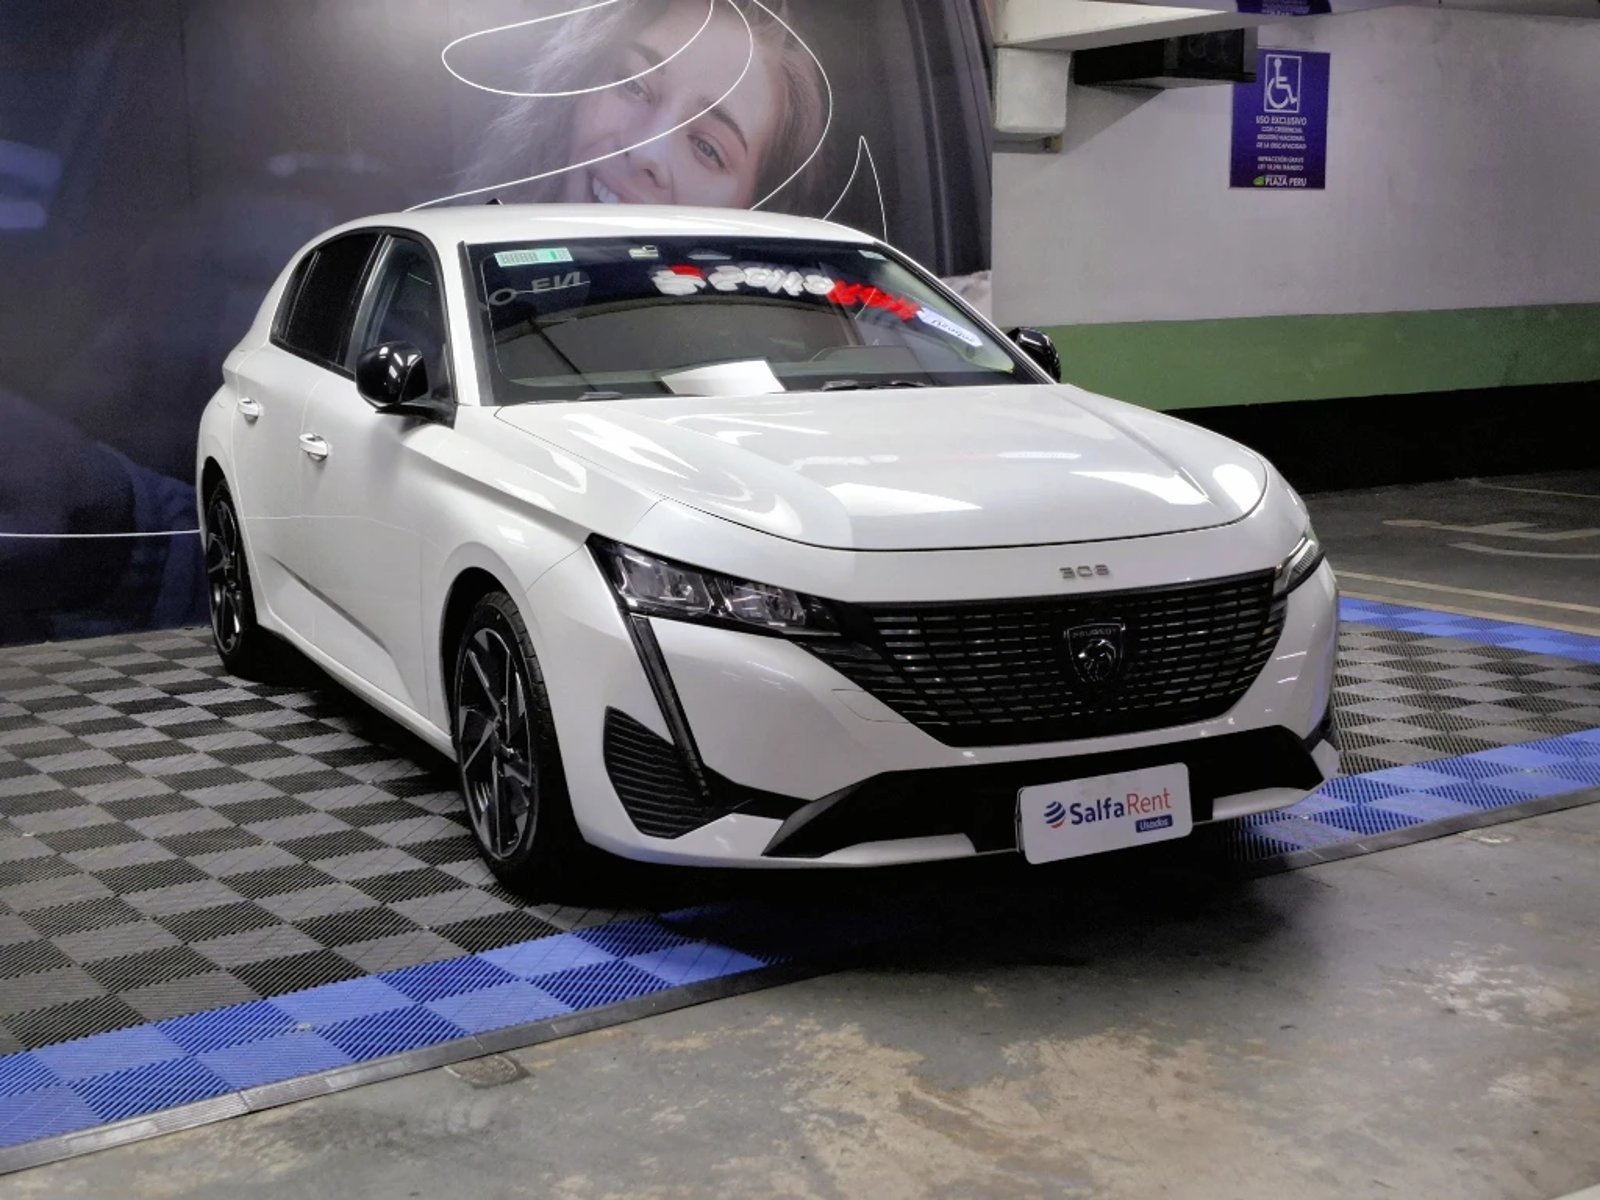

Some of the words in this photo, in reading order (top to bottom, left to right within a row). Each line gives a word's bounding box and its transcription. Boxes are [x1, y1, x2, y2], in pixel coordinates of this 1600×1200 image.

[1256, 115, 1270, 124] USO
[1271, 116, 1307, 126] EXCLUSIVO
[1265, 177, 1288, 187] PLAZA
[1289, 177, 1307, 187] PERU
[1059, 564, 1110, 579] 308
